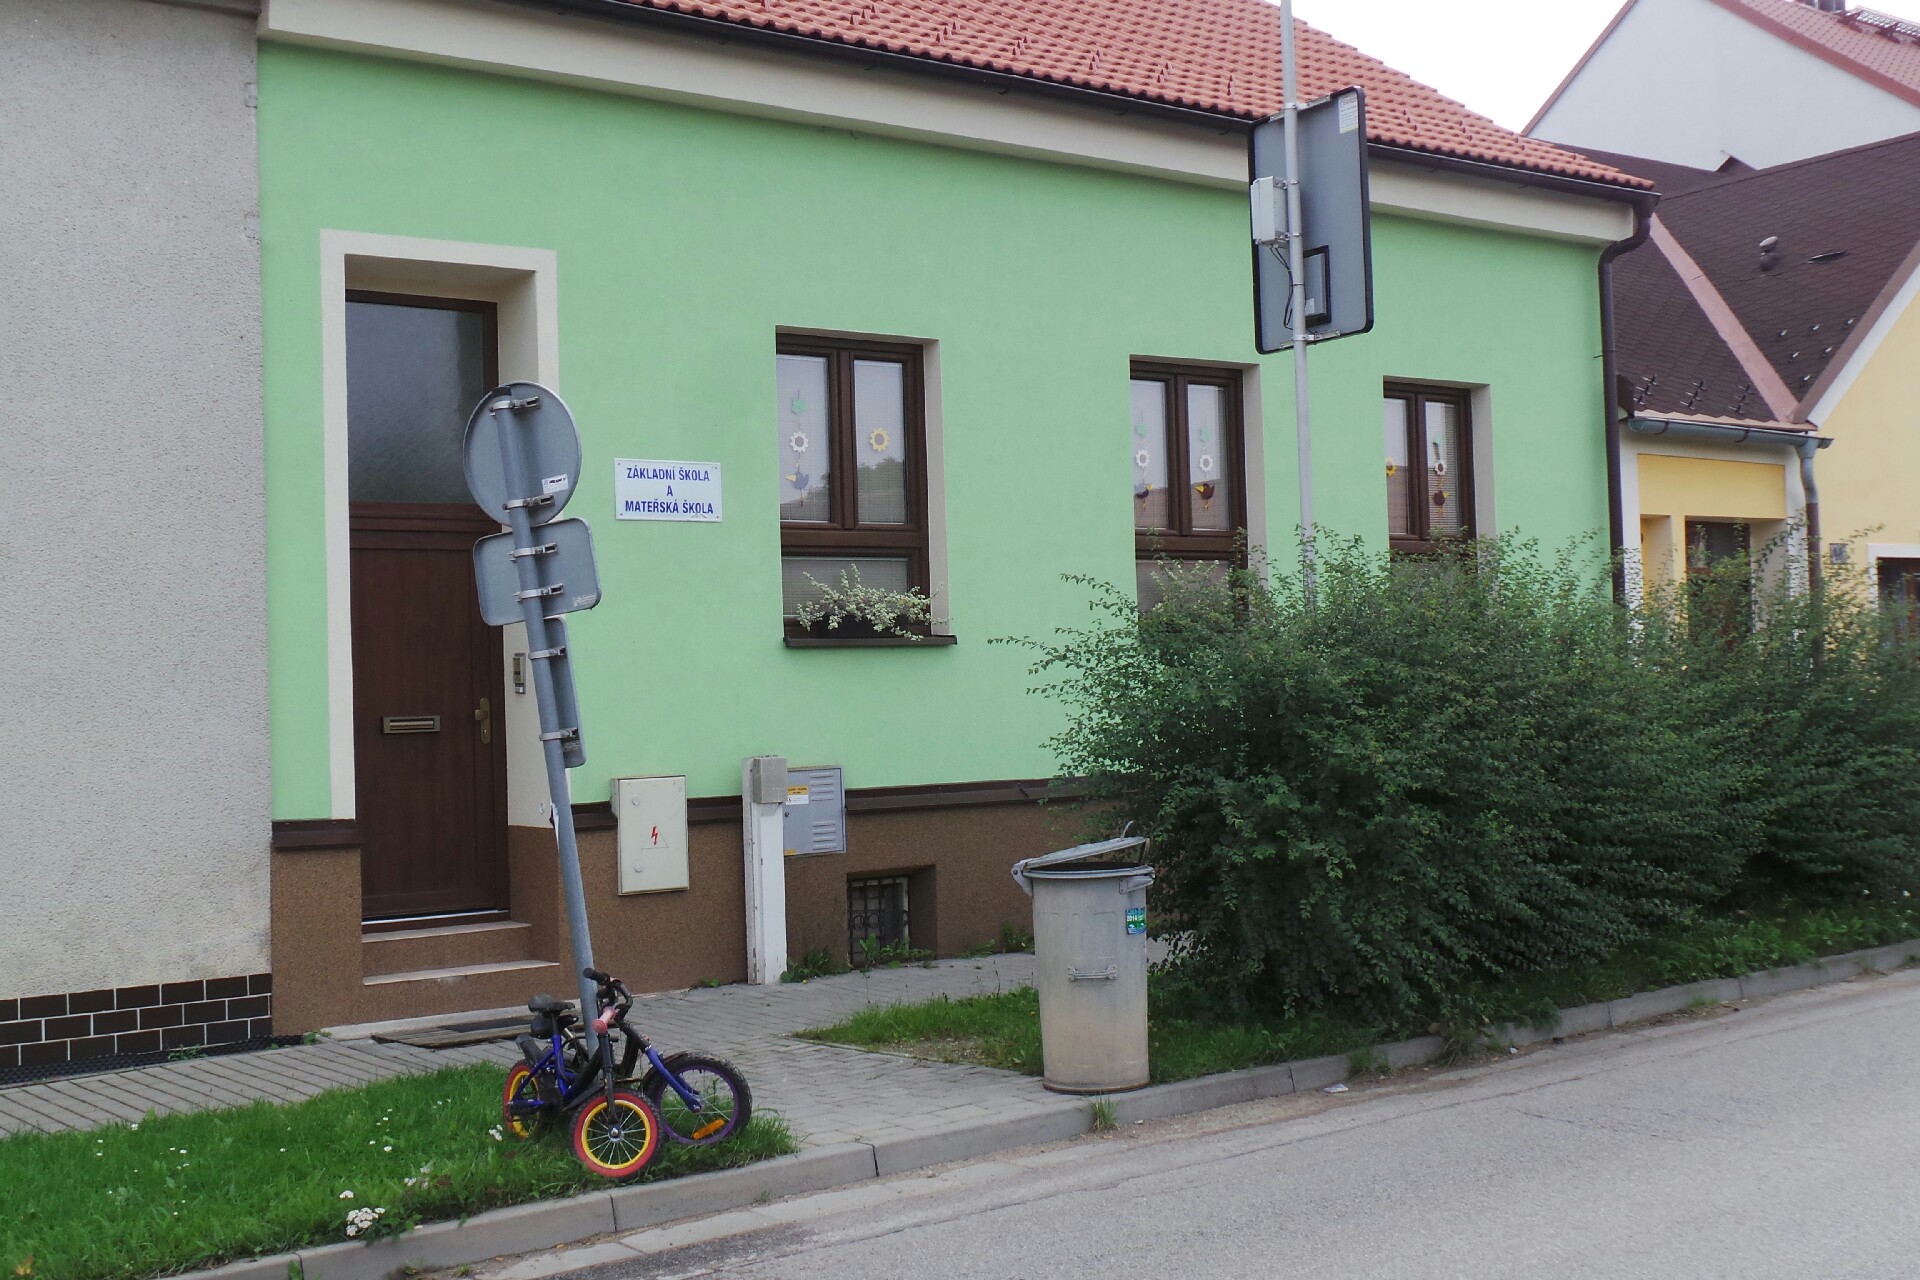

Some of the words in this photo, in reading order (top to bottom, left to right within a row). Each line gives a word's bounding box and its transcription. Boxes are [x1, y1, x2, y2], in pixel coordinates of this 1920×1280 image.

[627, 465, 676, 480] ZÁKLADNÍ
[679, 467, 710, 481] ŠKOLA
[666, 485, 673, 496] A
[625, 499, 679, 513] MATEŘSKÁ
[682, 500, 714, 514] ŠKOLA
